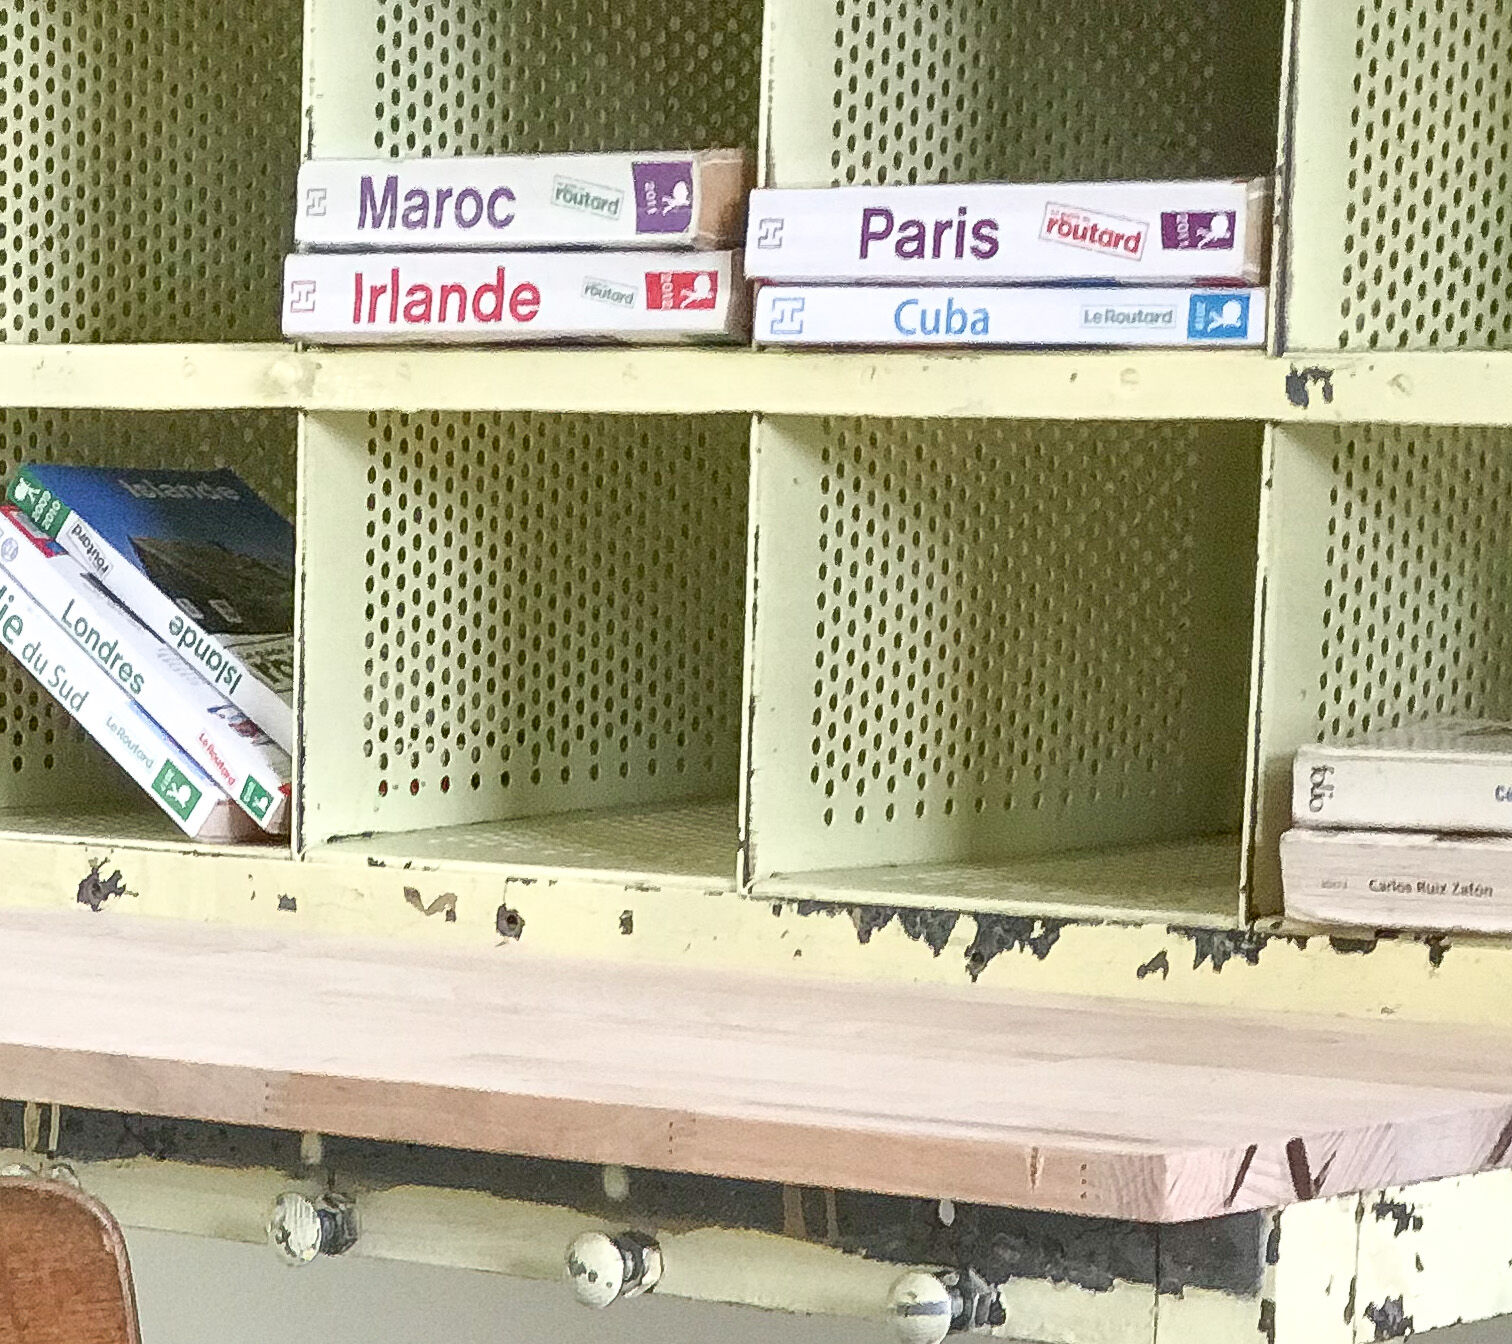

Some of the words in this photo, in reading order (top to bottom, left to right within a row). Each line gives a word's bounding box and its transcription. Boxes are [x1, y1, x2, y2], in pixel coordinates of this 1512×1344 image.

[357, 175, 516, 229] Maroc
[555, 185, 620, 215] routard
[859, 206, 999, 260] Paris
[1047, 217, 1141, 253] routard
[353, 266, 541, 324] Irlande
[584, 282, 635, 305] routard
[894, 297, 990, 335] Cuba
[72, 523, 110, 575] routard
[61, 599, 144, 694] Londres
[169, 616, 242, 696] Islande
[21, 641, 48, 675] du
[48, 664, 90, 712] Sud
[1309, 765, 1335, 812] folio
